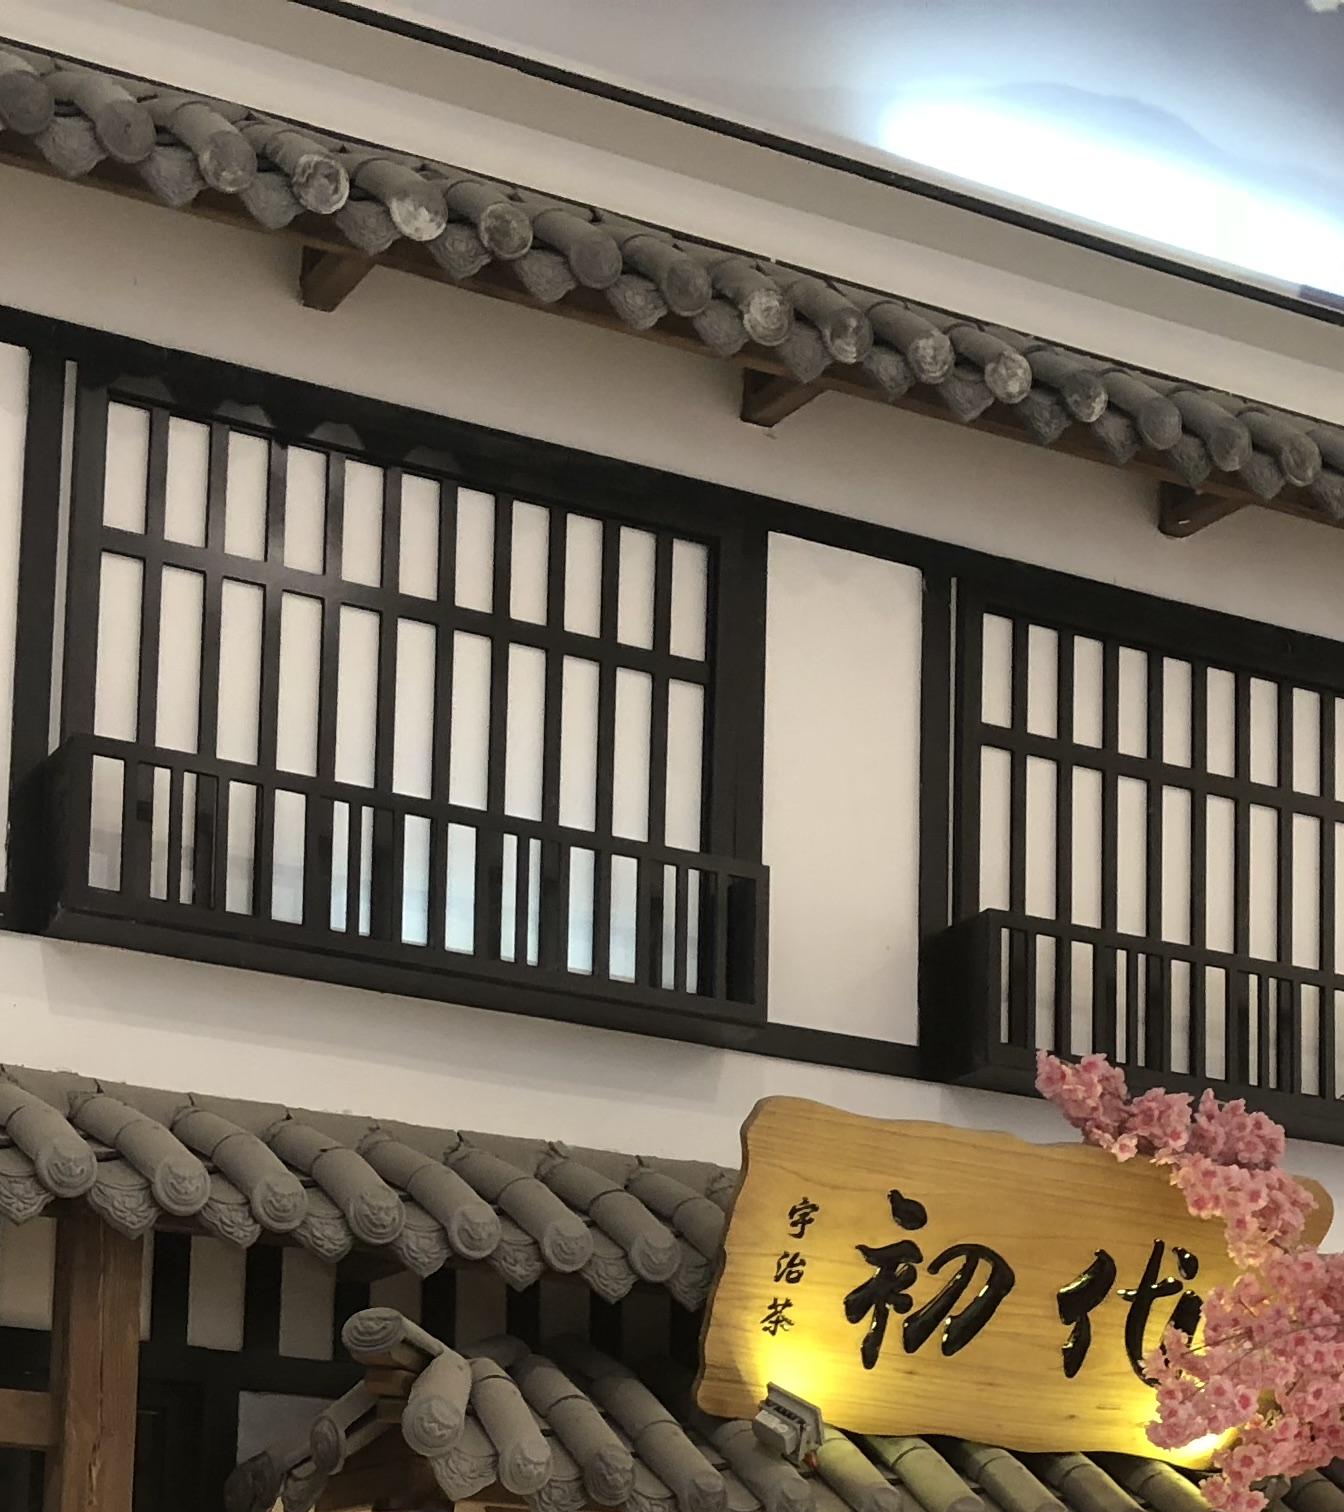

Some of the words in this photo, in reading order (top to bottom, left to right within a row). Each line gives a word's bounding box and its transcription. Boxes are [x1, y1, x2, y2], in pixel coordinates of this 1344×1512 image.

[759, 1197, 820, 1337] 宇治茶
[844, 1188, 1204, 1388] 初代
